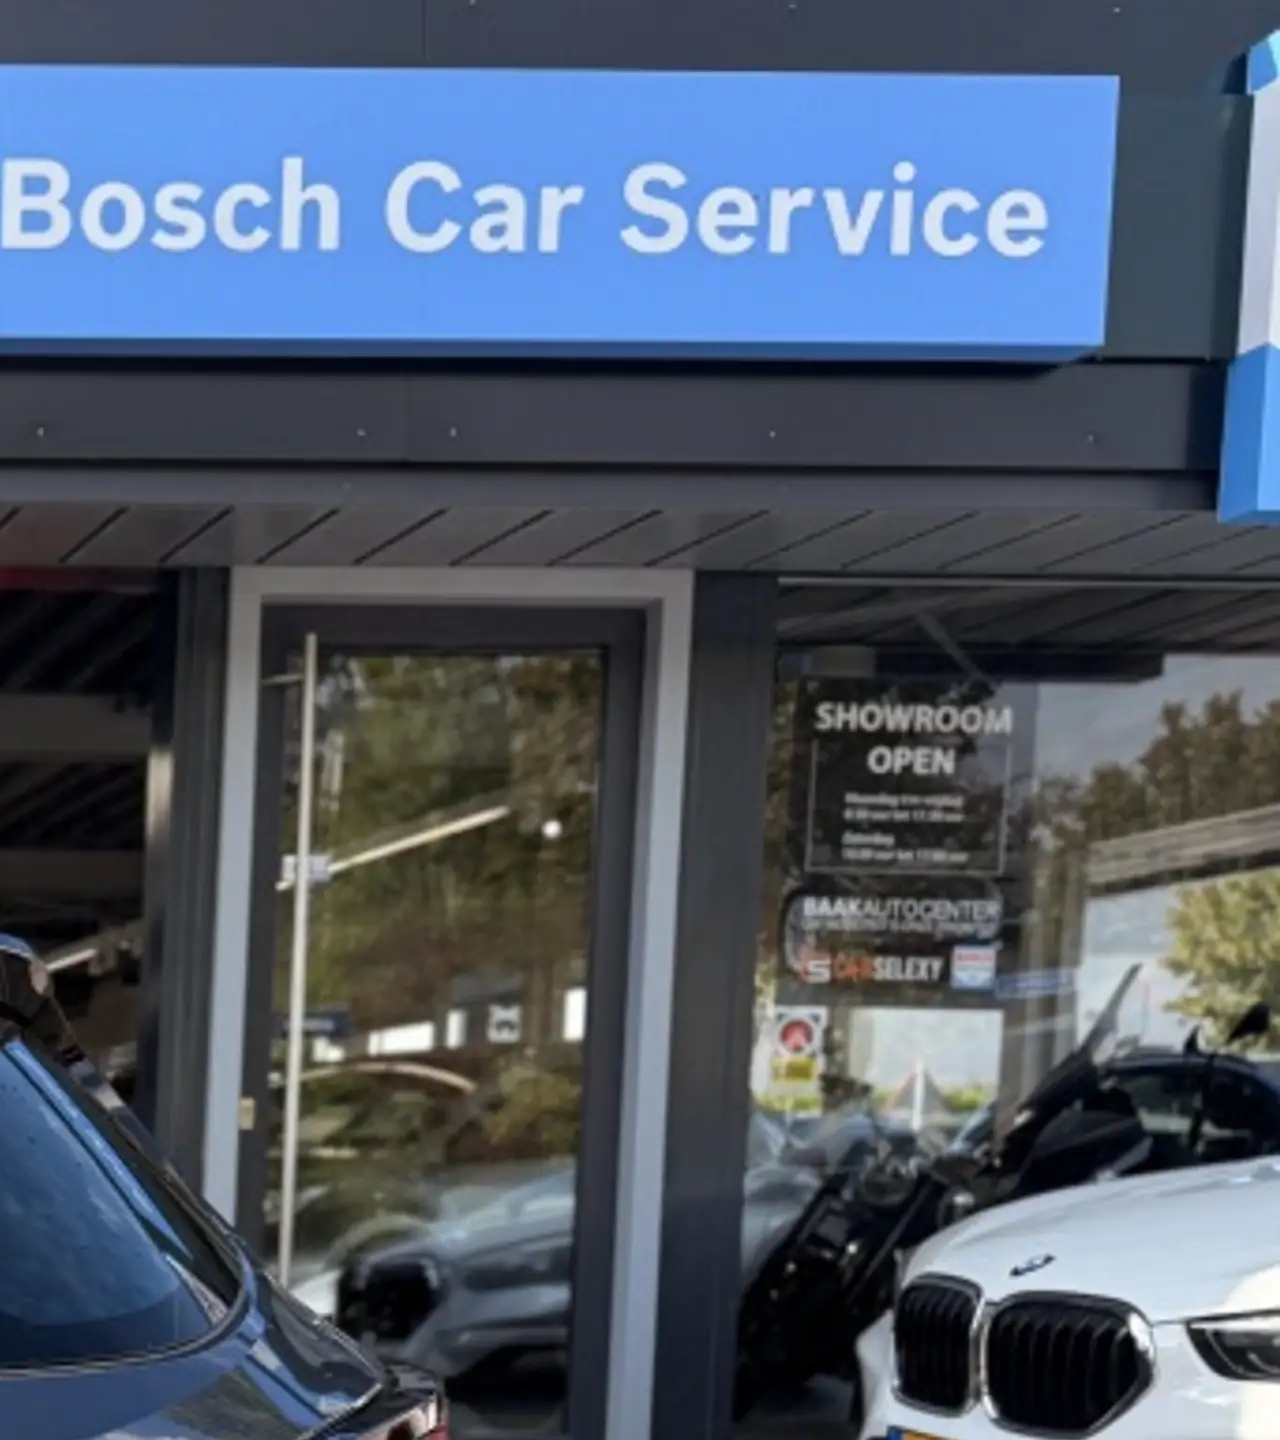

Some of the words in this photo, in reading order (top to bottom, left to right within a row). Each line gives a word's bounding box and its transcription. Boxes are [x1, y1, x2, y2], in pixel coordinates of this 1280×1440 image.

[385, 160, 584, 254] Car
[619, 162, 1049, 258] Service
[814, 703, 1013, 735] SHOWROOM
[866, 745, 956, 776] OPEN
